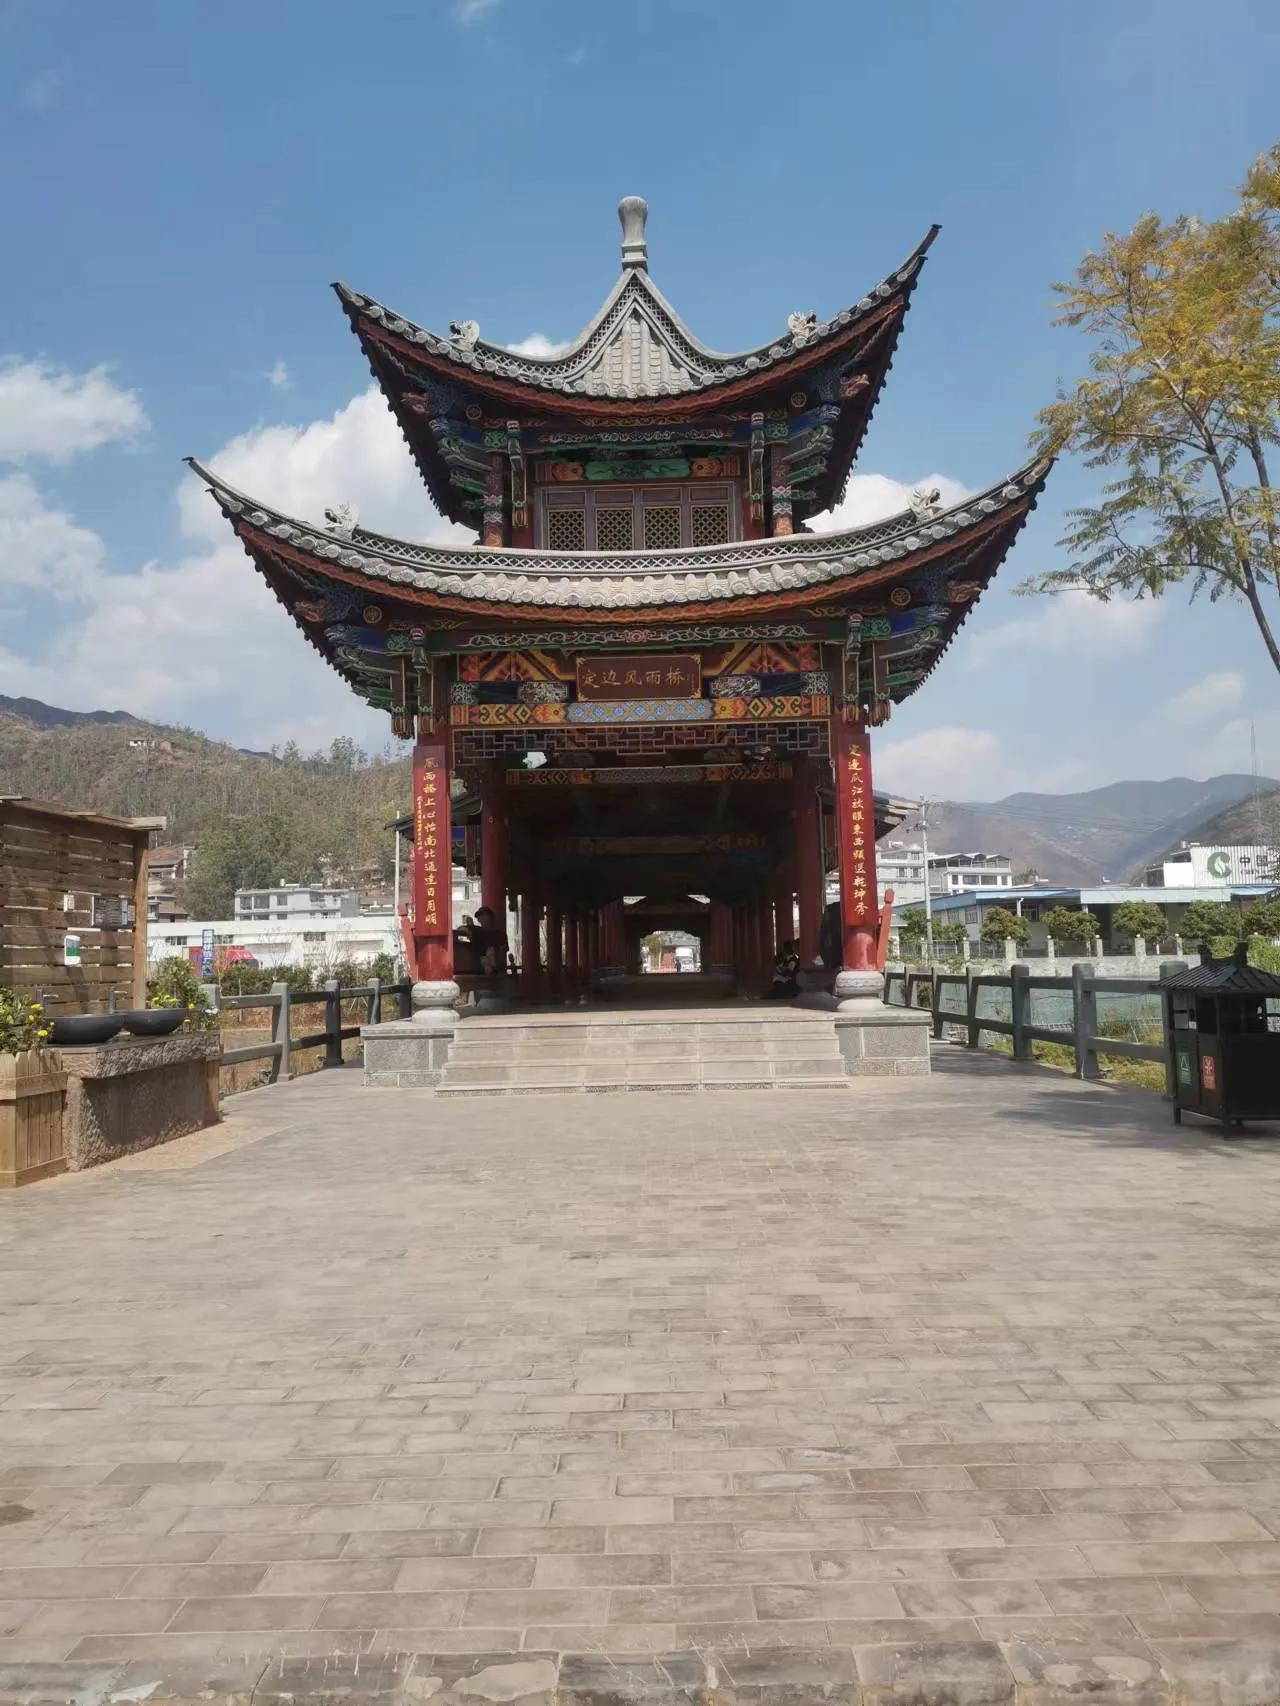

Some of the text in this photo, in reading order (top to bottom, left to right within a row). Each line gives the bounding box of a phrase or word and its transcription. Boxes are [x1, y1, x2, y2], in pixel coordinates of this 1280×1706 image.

[582, 666, 685, 689] 定边风雨桥
[1240, 854, 1280, 868] 中国
